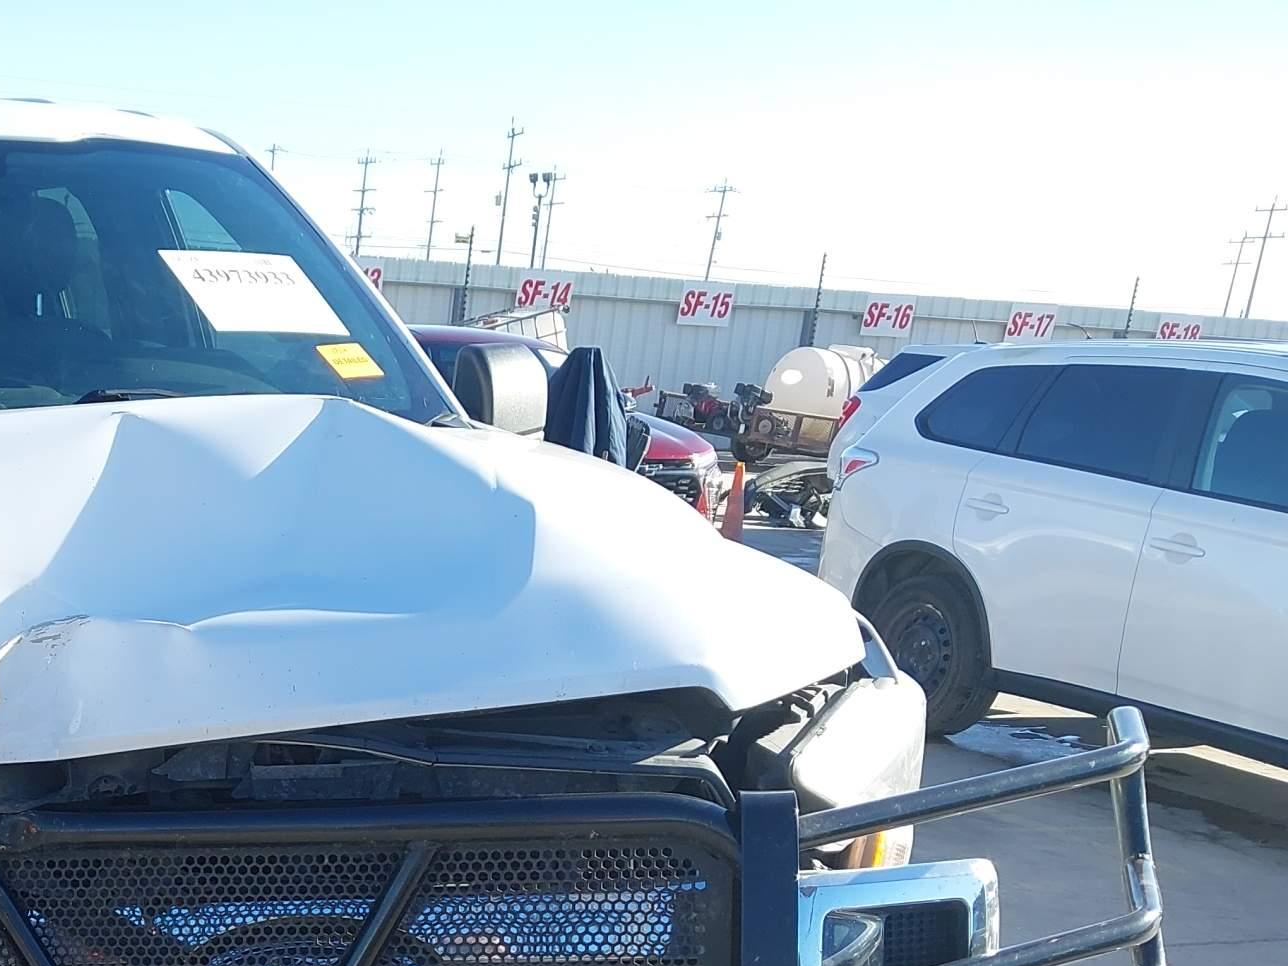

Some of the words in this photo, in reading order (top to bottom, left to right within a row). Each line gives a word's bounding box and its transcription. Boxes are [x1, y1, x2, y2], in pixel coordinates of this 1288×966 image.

[193, 268, 296, 286] 43973933
[518, 279, 572, 306] SF-14
[680, 289, 733, 319] SF-15
[864, 301, 915, 330] SF-16
[1008, 311, 1055, 338] SF-17
